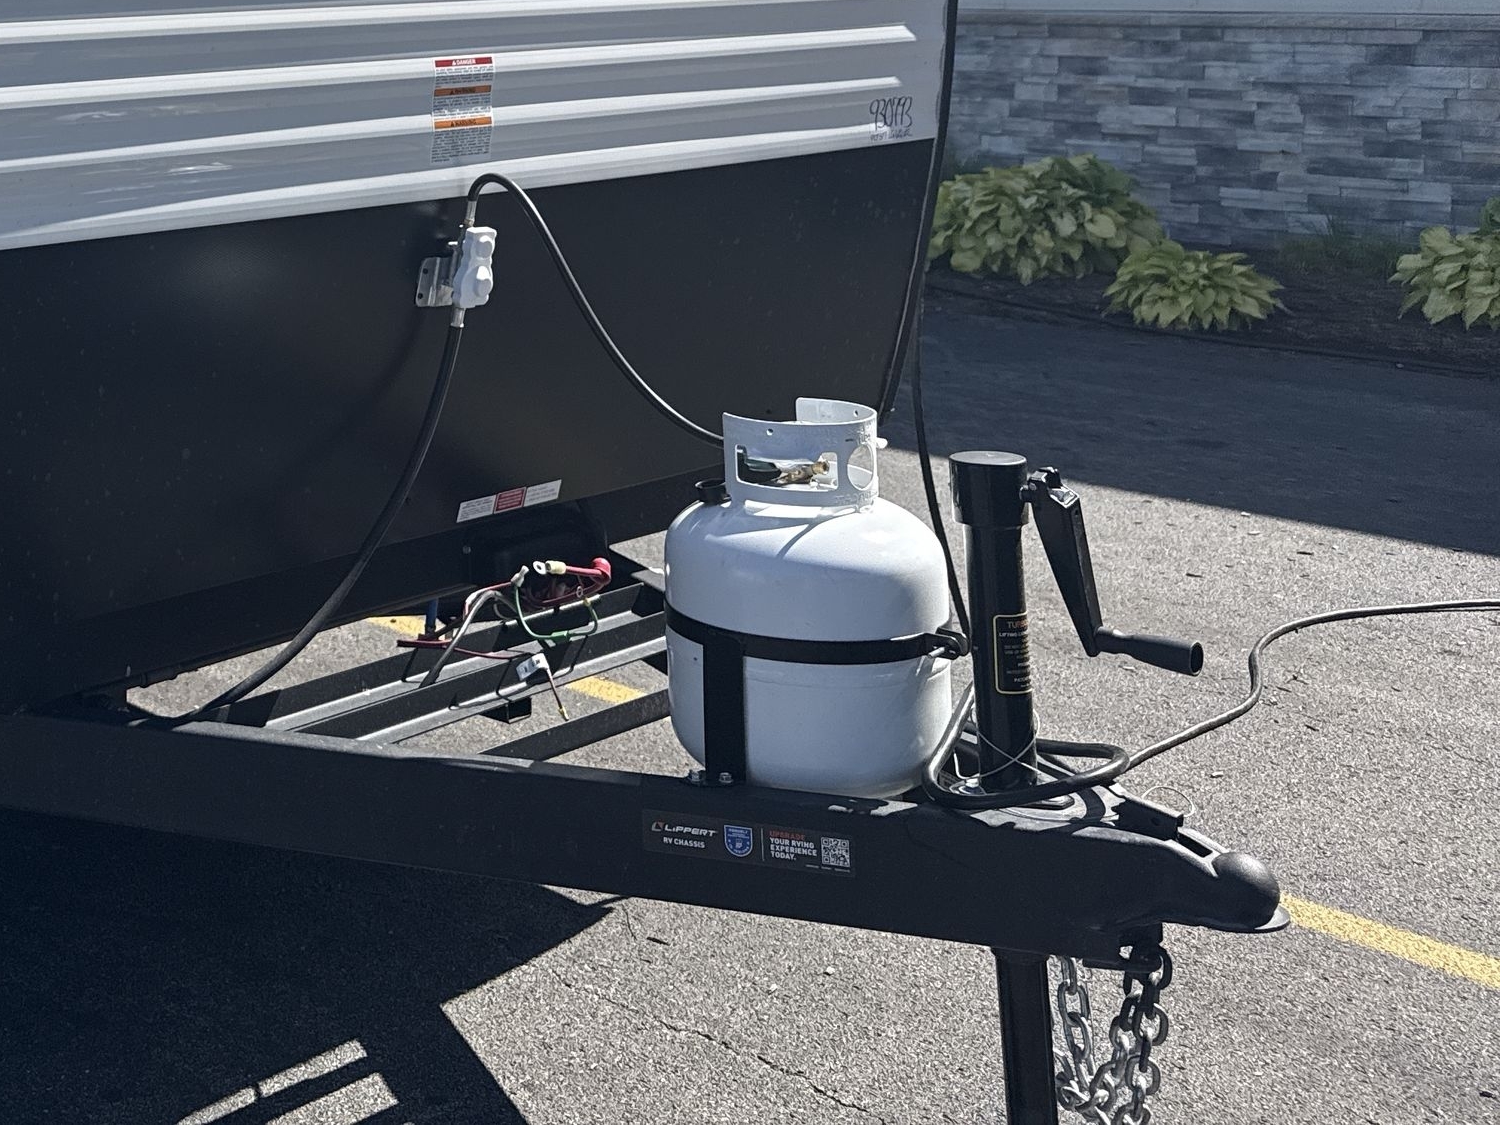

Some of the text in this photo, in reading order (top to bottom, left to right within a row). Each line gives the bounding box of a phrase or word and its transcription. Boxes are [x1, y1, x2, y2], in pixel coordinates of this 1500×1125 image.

[673, 838, 706, 849] CHASSIS
[769, 837, 790, 847] YOUR
[770, 844, 818, 857] EXPERIENCE
[770, 850, 797, 861] TODAY.
